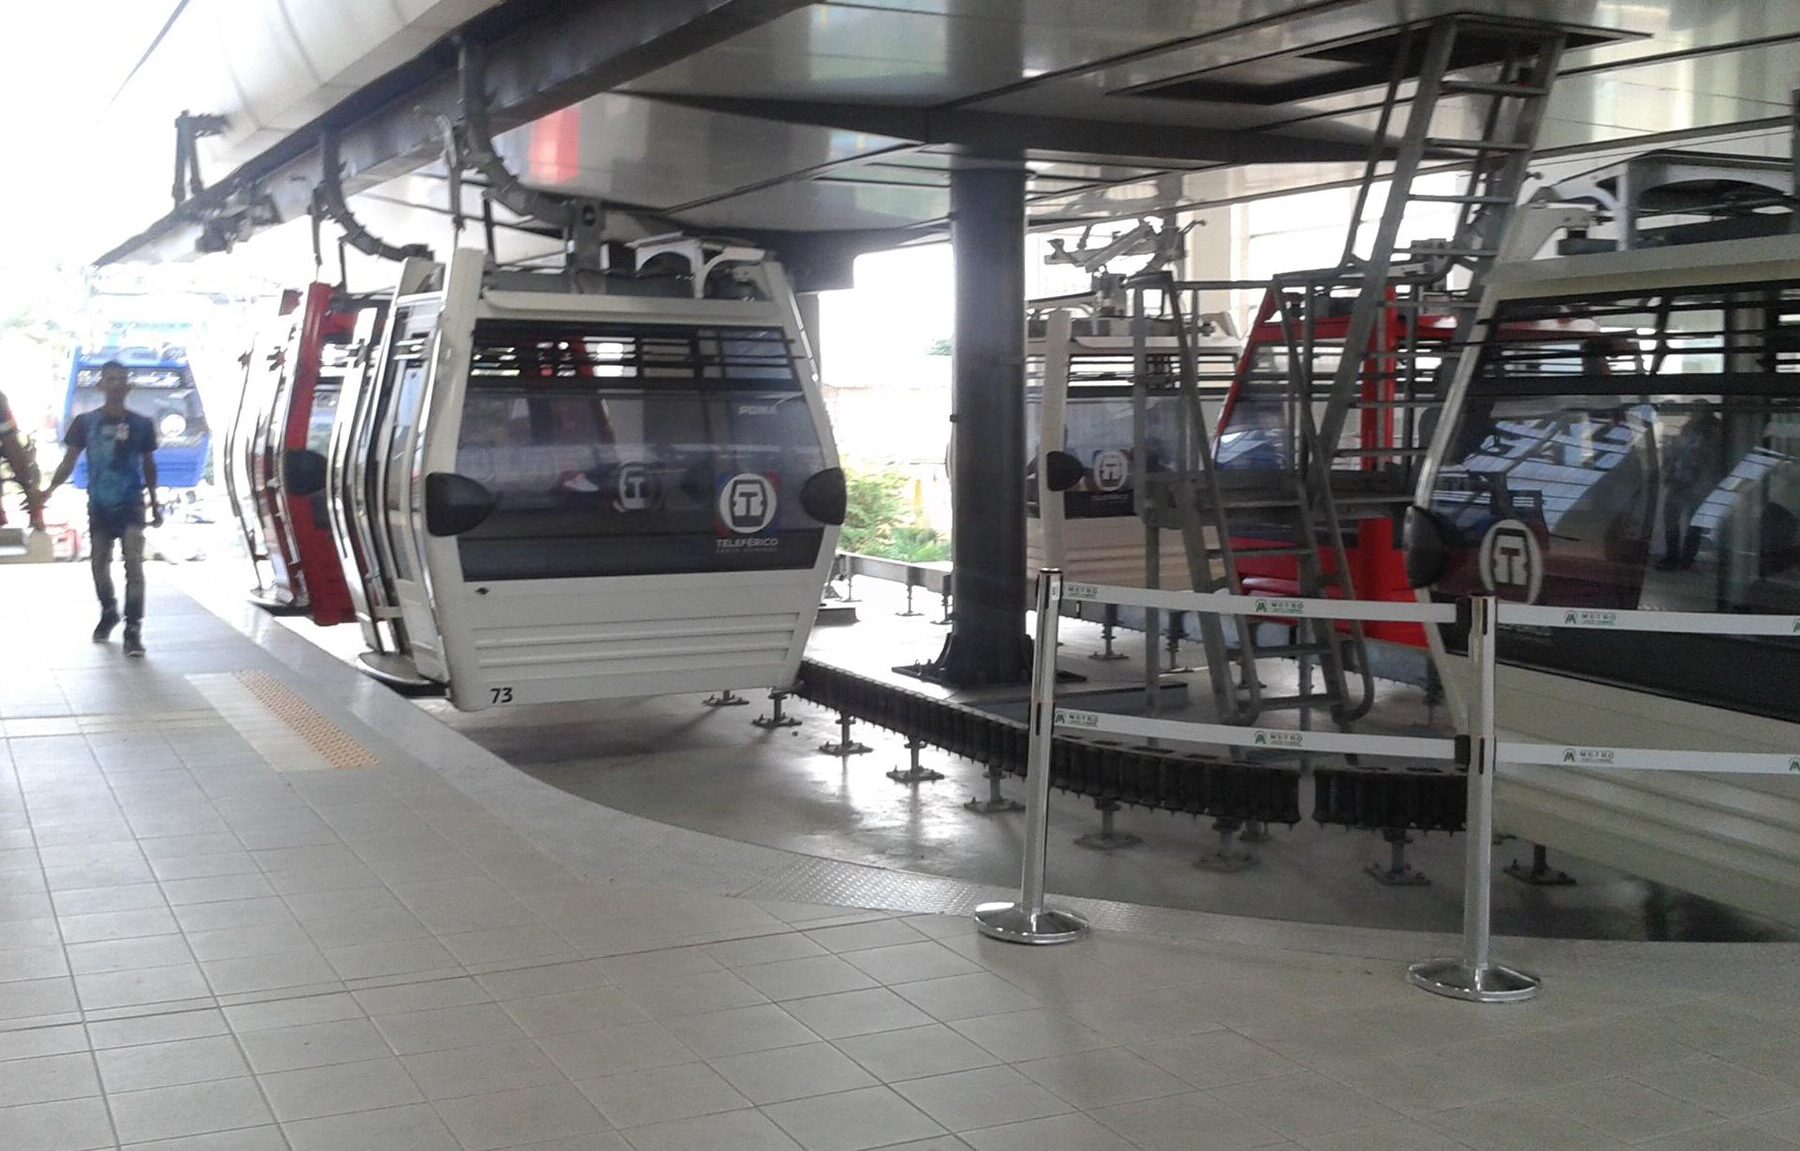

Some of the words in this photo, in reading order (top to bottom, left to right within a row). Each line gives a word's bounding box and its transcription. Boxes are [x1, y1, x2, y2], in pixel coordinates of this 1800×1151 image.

[1068, 584, 1098, 595] METRO
[1271, 601, 1304, 609] METRO
[1581, 612, 1616, 621] METRO
[490, 687, 512, 704] 73
[1069, 713, 1098, 723] METRO
[1270, 732, 1303, 742] METRO
[1580, 750, 1614, 759] METRO
